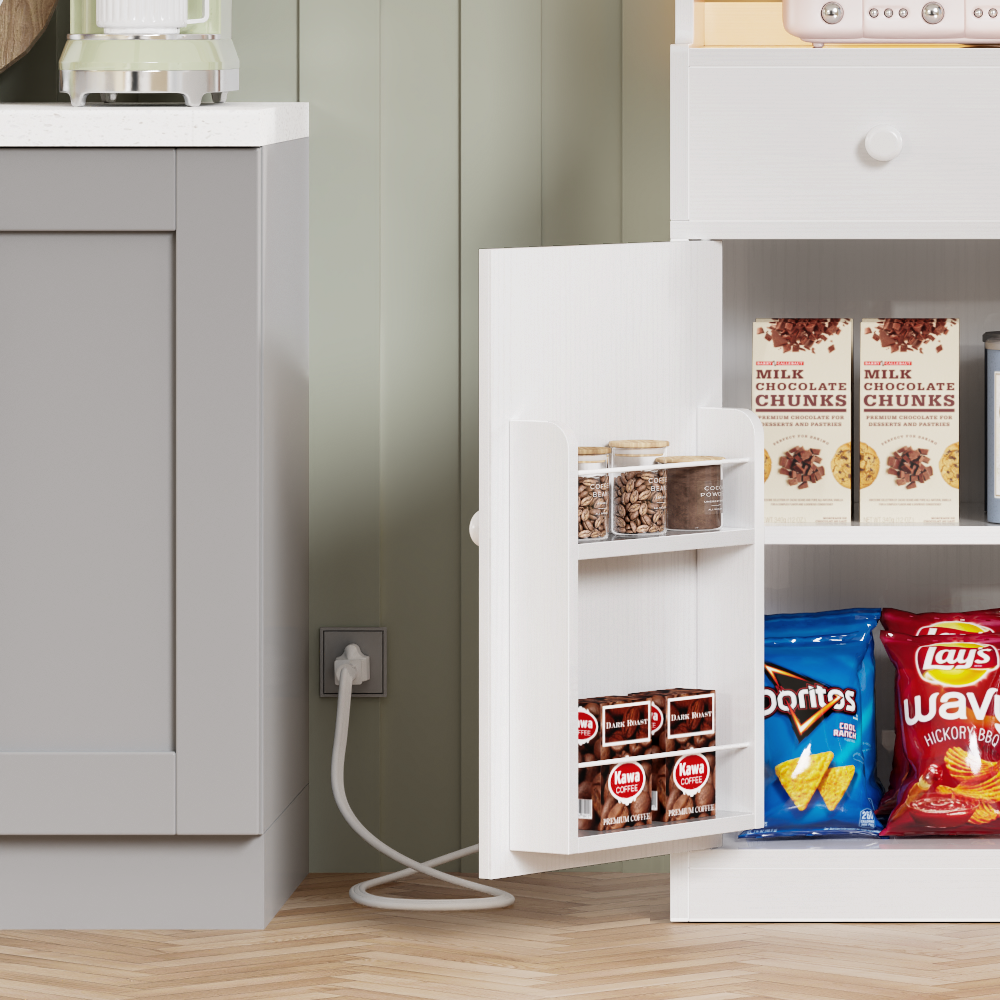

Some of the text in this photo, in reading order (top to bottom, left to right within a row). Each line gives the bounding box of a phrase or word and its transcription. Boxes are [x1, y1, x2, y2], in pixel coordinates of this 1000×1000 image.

[756, 369, 804, 379] MILK
[864, 369, 912, 379] MILK
[755, 382, 847, 391] CHOCOLATE
[863, 382, 955, 391] CHOCOLATE
[755, 394, 847, 407] CHUNKS
[863, 394, 955, 407] CHUNKS
[922, 646, 993, 671] Lay's
[671, 711, 713, 721] DARK ROAST
[606, 718, 649, 729] DARK ROAST
[839, 722, 856, 732] COOL
[833, 729, 857, 740] RANCH
[923, 725, 1000, 748] HICKORY BBQ
[679, 762, 705, 777] Kawa
[614, 770, 641, 785] Kawa
[680, 776, 702, 786] COFFEE
[615, 784, 639, 794] COFFEE
[668, 803, 715, 817] PREMIUM COFFEE
[603, 812, 651, 826] PREMIUM COFFEE
